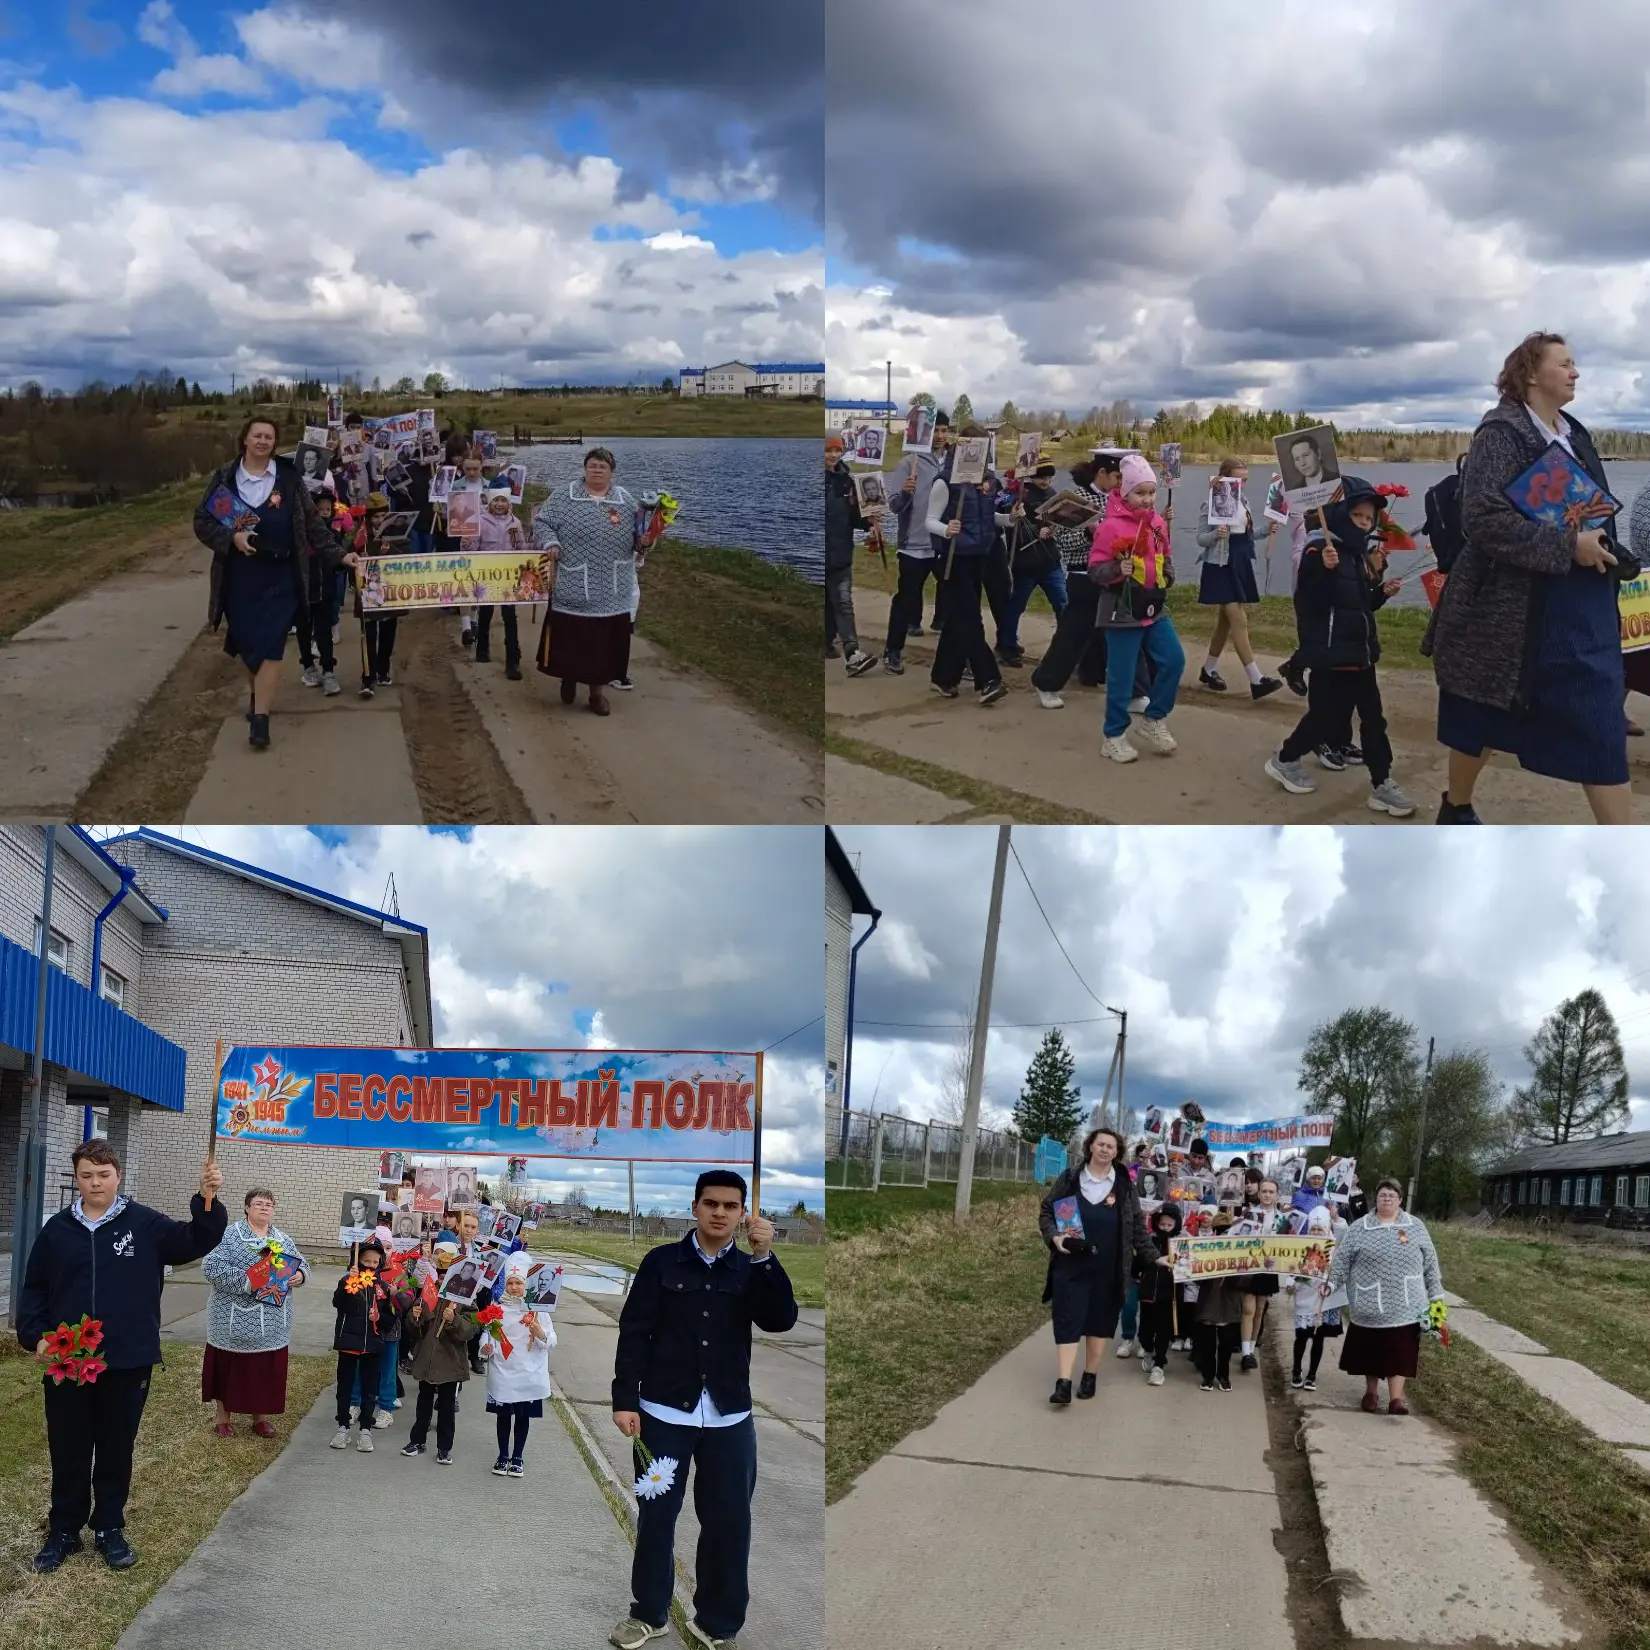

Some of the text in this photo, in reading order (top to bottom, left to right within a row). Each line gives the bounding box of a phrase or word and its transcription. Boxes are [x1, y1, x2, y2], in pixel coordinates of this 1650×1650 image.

[454, 568, 519, 583] САЛЮТ!
[382, 581, 469, 602] ПОБЕДА
[313, 1069, 754, 1132] БЕССМЕРТНЫЙ ПОЛК
[252, 1100, 286, 1122] 1945
[1301, 1120, 1333, 1138] ПОЛК
[1249, 1247, 1307, 1259] САЛЮТ!
[1191, 1256, 1260, 1274] ПОБЕДА
